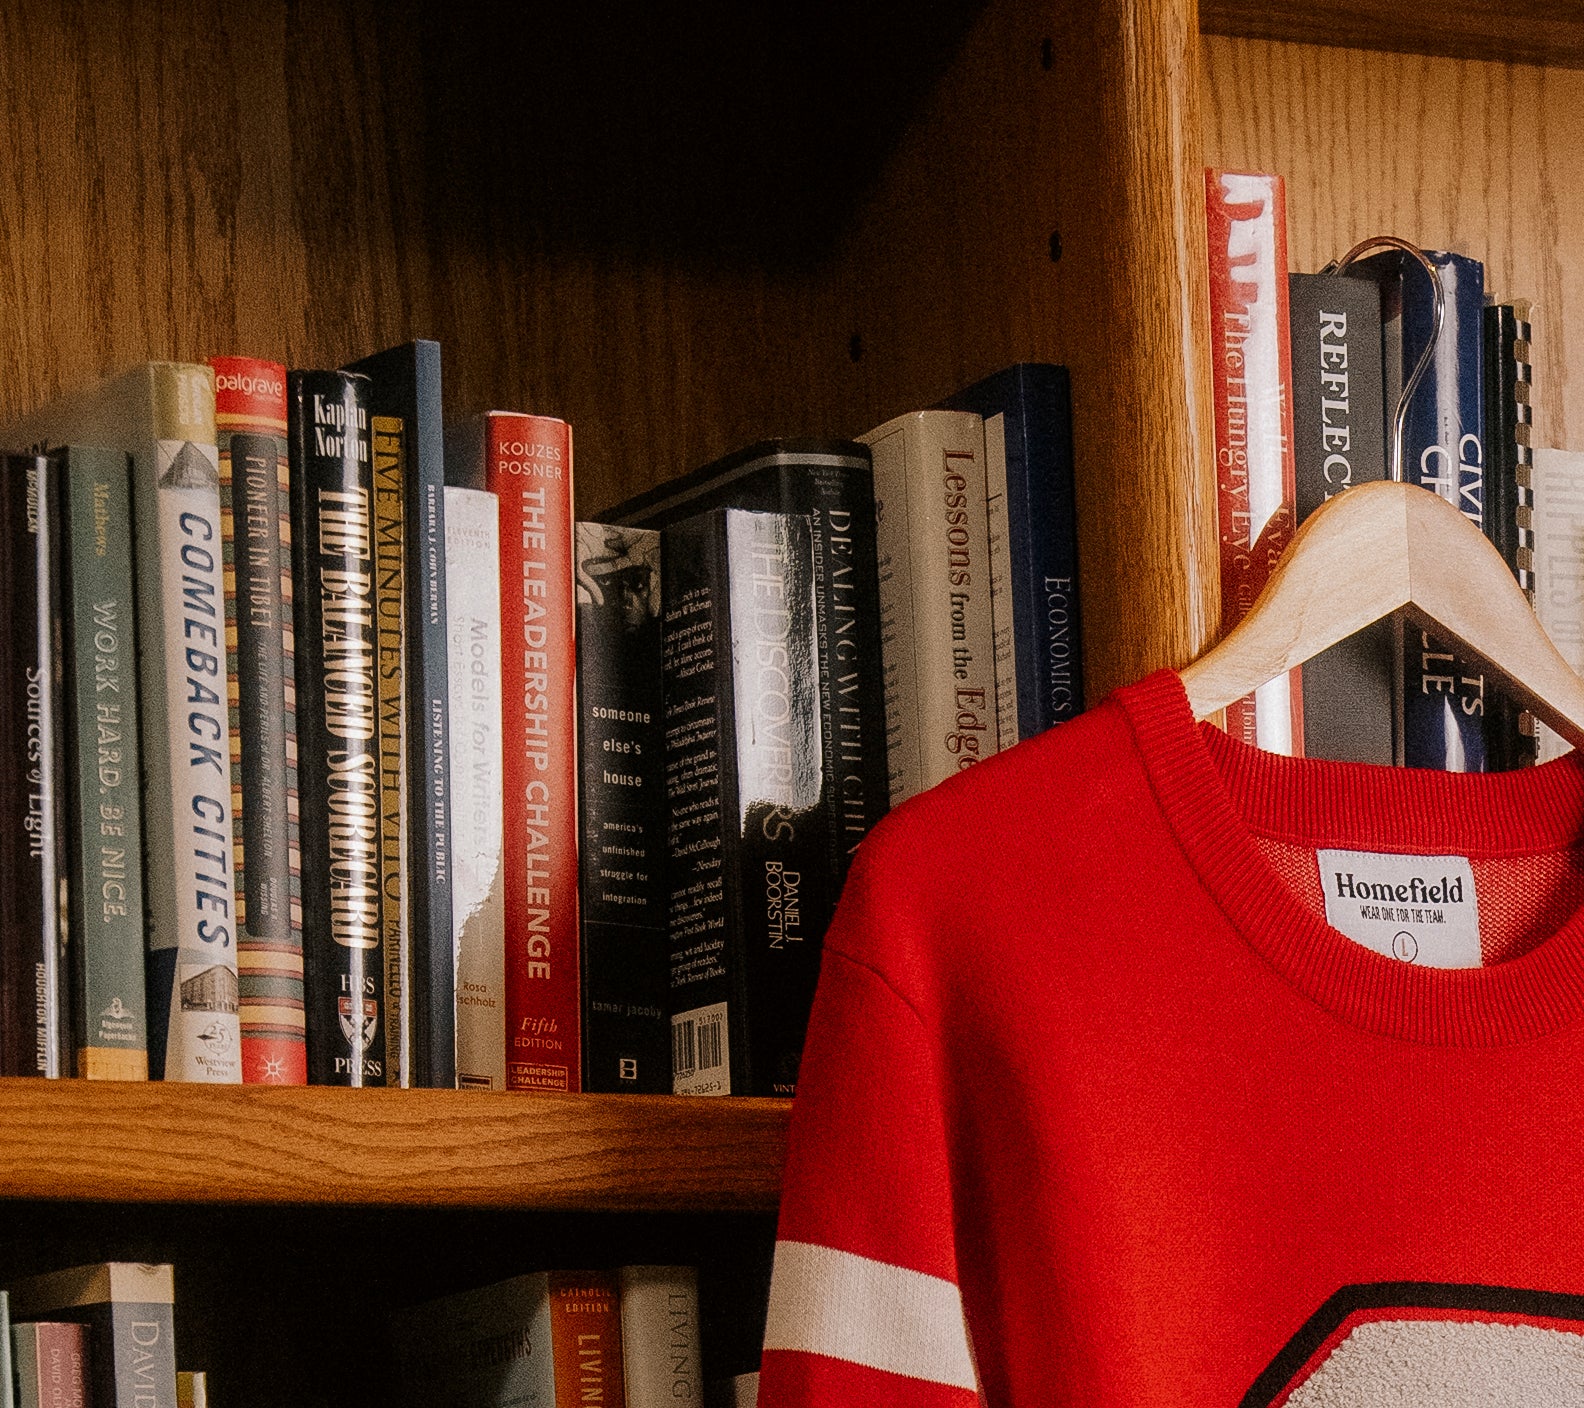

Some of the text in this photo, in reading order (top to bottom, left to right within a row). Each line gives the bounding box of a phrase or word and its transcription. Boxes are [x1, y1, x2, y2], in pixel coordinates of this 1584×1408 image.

[315, 394, 366, 425] Kaplan
[315, 426, 369, 460] Norton
[500, 442, 561, 460] KOUZES
[500, 461, 562, 480] POSNER
[942, 449, 985, 771] Lessons from the Edge
[179, 511, 229, 947] COMEBACK CITIES
[318, 486, 379, 948] THE BALANCED SCORECARD
[521, 488, 551, 980] THE LEADERSHIP CHALLENGE
[93, 601, 127, 923] WORK HARD. BE NICE.
[1335, 873, 1463, 903] Homefield
[1360, 906, 1380, 920] WEAR
[1382, 907, 1394, 921] ONE
[1397, 909, 1409, 922] FOR
[1412, 909, 1424, 923] THE
